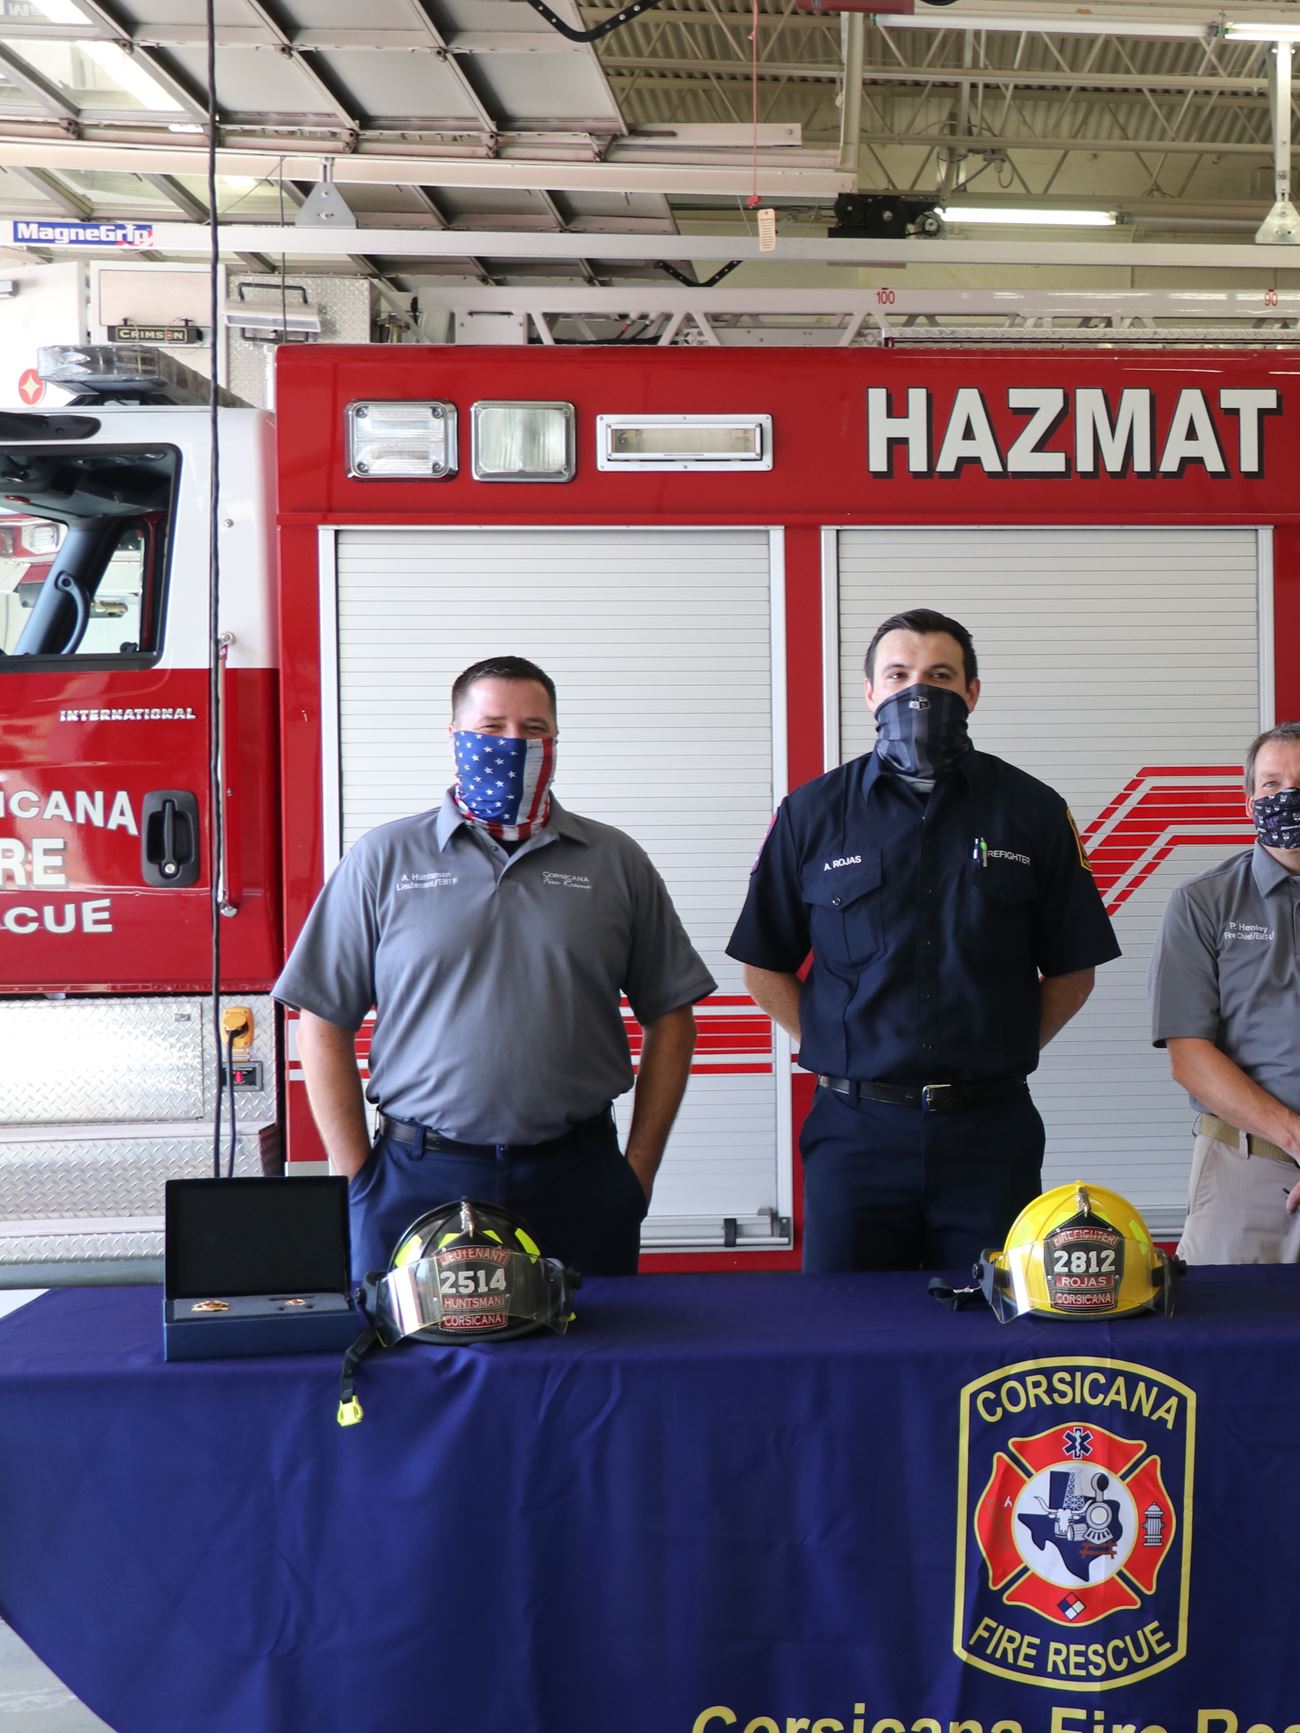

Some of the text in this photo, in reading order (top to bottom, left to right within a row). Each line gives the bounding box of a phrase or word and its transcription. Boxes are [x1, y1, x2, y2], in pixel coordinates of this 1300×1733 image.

[18, 223, 149, 246] MagneGrip
[876, 290, 895, 305] 100
[1264, 291, 1279, 307] 90
[119, 328, 184, 340] CRIMSON
[867, 387, 1281, 478] HAZMAT
[60, 707, 196, 722] INTERNATIONAL
[832, 855, 862, 869] ROJAS
[987, 850, 1031, 865] REFIGHTER
[542, 871, 590, 883] CORSICANA
[3, 898, 113, 934] CUE
[1238, 922, 1268, 934] Henley
[440, 1246, 508, 1265] LIEUTENANT
[1053, 1249, 1116, 1273] 2812
[440, 1268, 507, 1294] 2514
[1061, 1276, 1107, 1287] ROJAS
[444, 1295, 502, 1308] HUNTSMAN
[1056, 1293, 1112, 1305] CORSICANA
[444, 1313, 502, 1327] CORSICANA
[976, 1371, 1179, 1430] CORSICANA
[968, 1616, 1172, 1676] FIRE RESCUE
